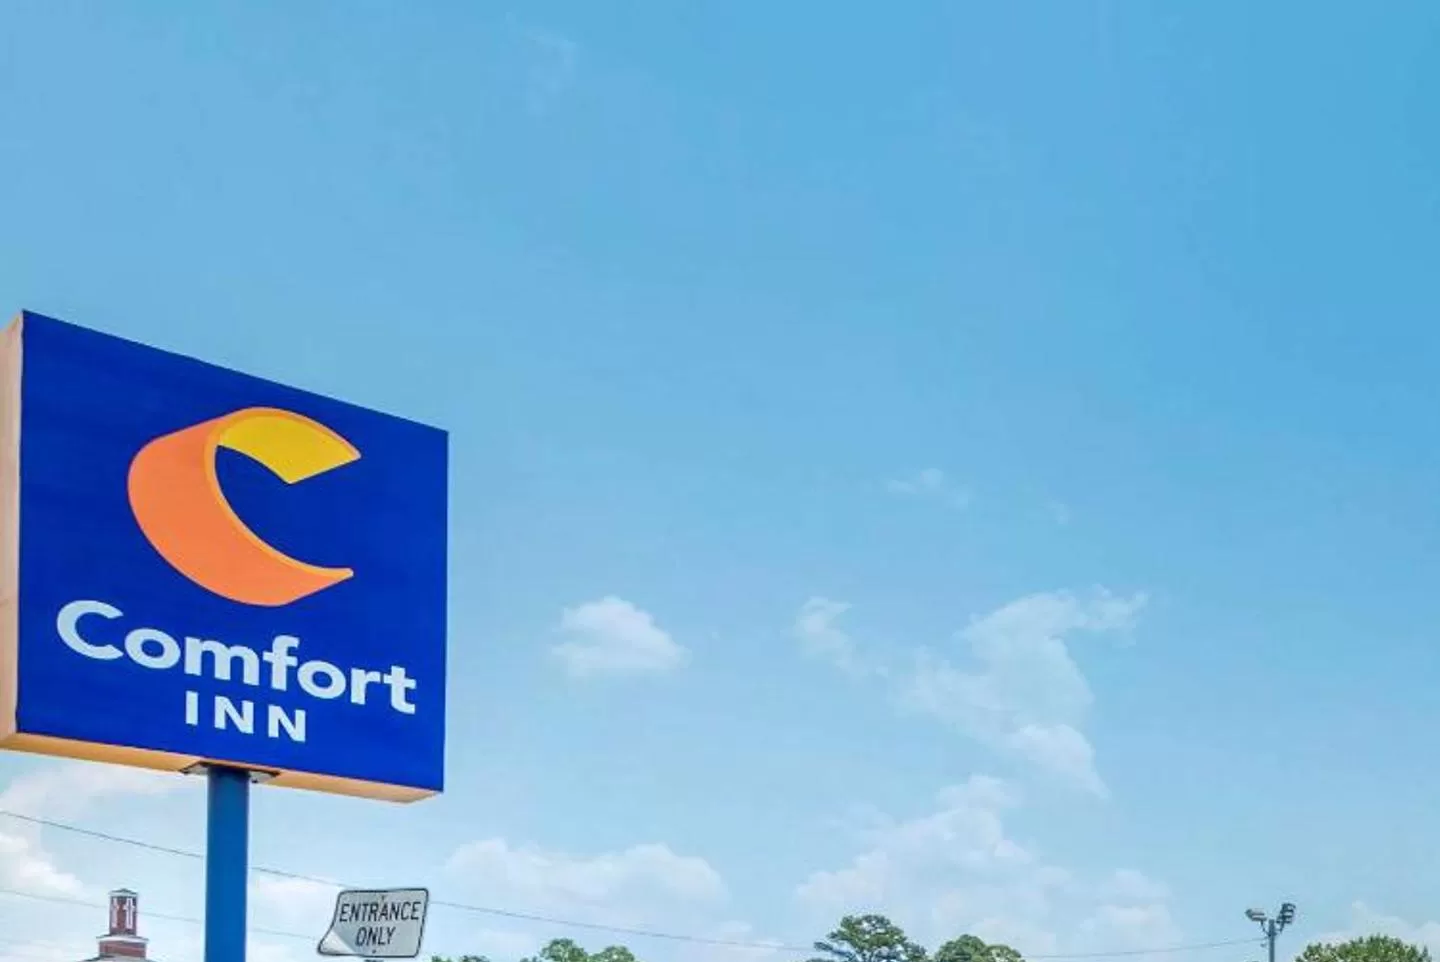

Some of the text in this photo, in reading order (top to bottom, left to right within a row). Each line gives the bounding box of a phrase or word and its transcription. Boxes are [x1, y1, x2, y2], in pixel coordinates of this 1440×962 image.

[57, 600, 417, 715] Comfort
[185, 690, 306, 743] INN
[340, 901, 421, 922] ENTRANCE
[355, 926, 396, 946] ONLY
